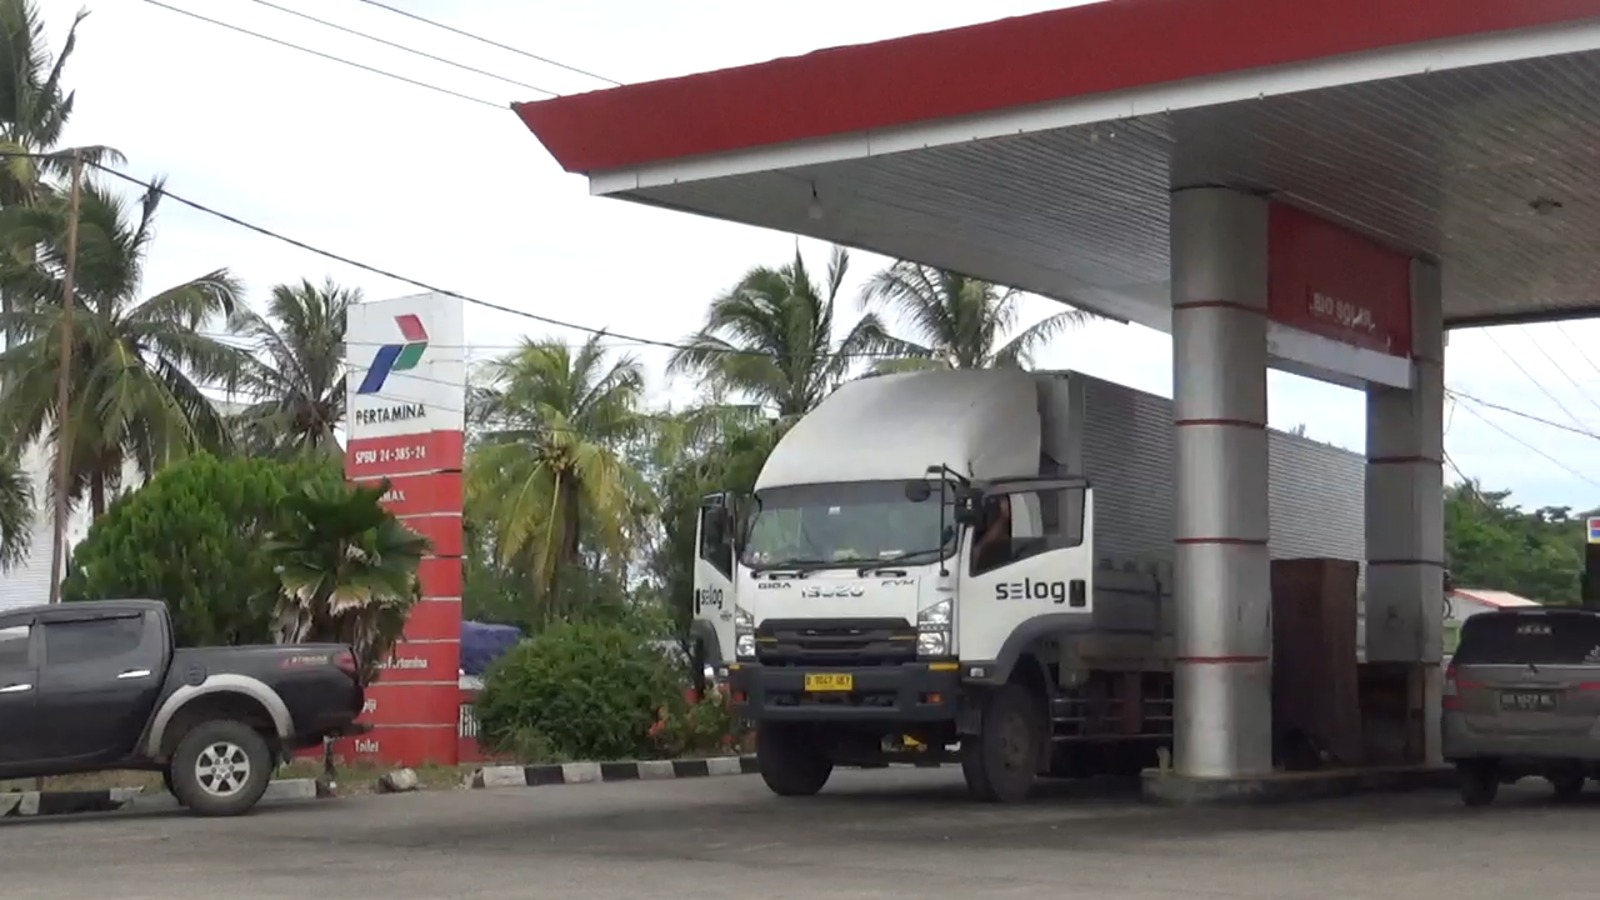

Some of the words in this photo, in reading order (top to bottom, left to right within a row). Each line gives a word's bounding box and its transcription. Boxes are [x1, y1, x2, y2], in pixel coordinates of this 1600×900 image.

[356, 403, 426, 425] PERTAMINA
[355, 449, 377, 465] SPBU
[380, 445, 426, 462] 24-385-24
[701, 584, 723, 610] selog
[802, 585, 864, 597] ISUZU
[995, 577, 1065, 604] selog
[355, 739, 379, 752] Toilet
